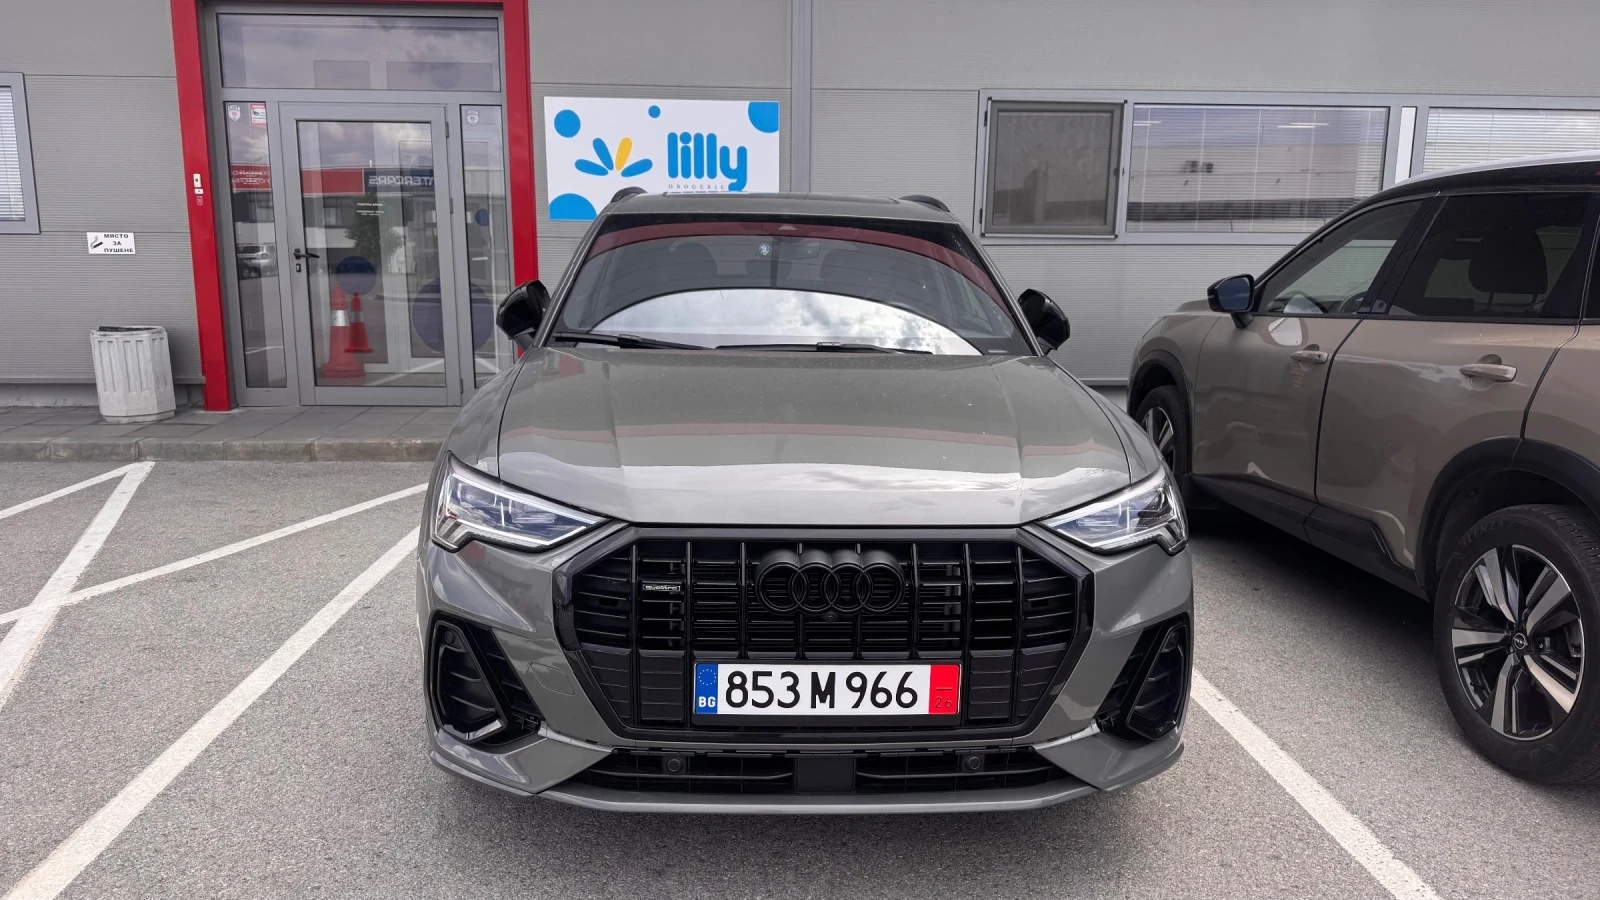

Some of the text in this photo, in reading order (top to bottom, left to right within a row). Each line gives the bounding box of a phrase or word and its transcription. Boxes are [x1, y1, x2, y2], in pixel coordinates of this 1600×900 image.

[667, 131, 747, 192] lilly
[698, 695, 717, 708] BG
[725, 670, 918, 709] 853 M 966
[934, 696, 953, 709] 26
